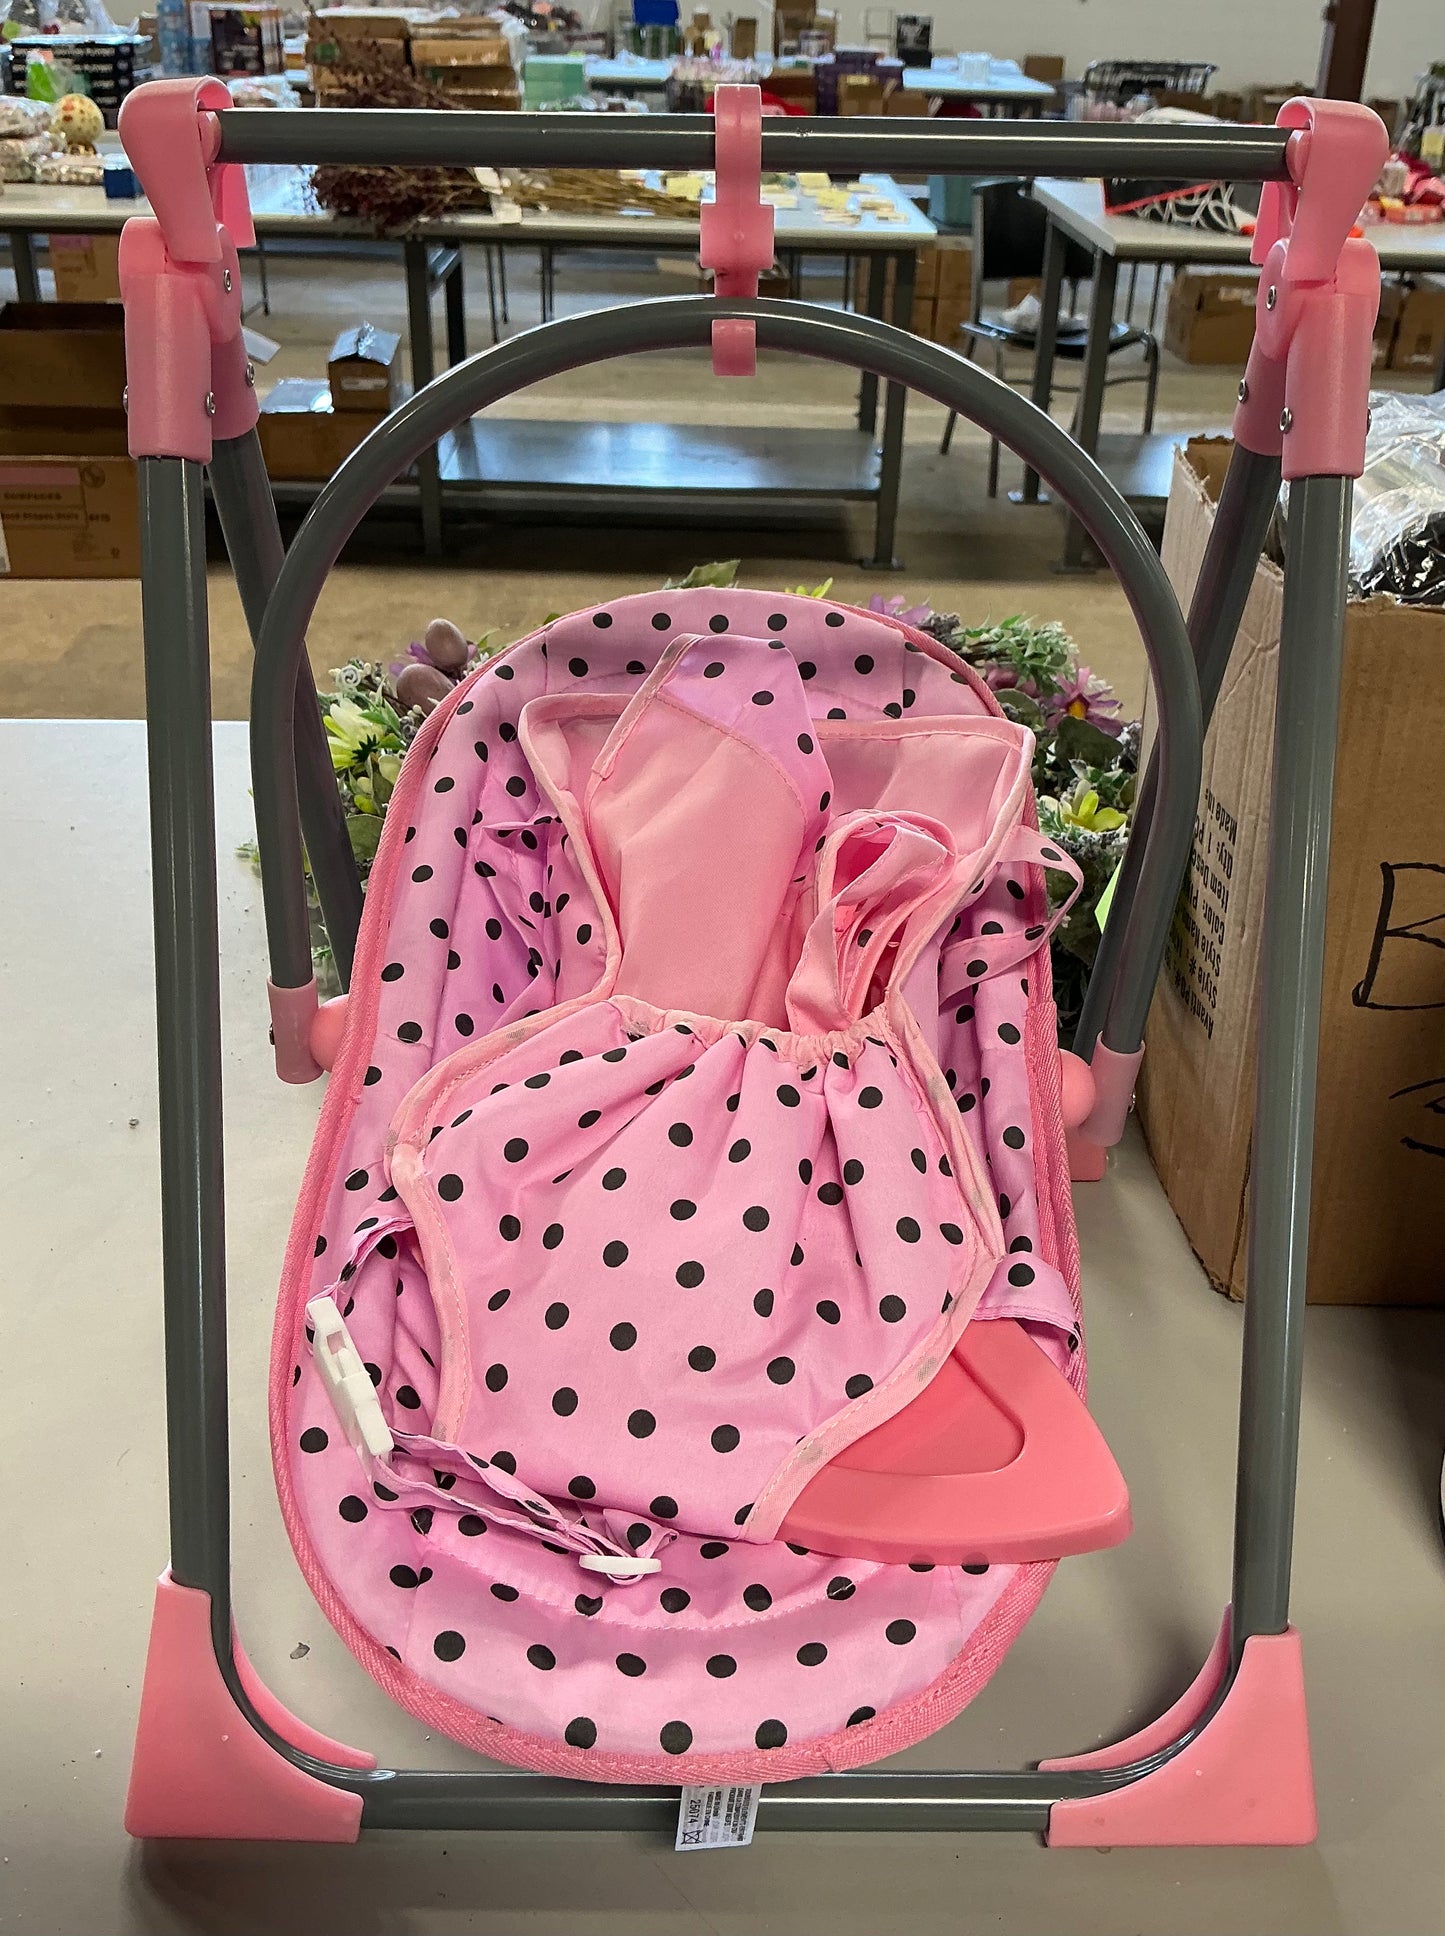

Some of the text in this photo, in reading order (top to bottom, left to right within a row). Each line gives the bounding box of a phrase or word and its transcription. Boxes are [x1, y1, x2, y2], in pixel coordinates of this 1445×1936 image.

[1205, 788, 1237, 847] Made in:
[1217, 841, 1233, 879] Qty:
[1210, 872, 1229, 913] Item
[1202, 899, 1225, 945] Color:
[1201, 935, 1221, 977] Style
[1198, 966, 1217, 1009] Style
[1190, 990, 1214, 1040] Avanti
[688, 1799, 702, 1824] 25074
